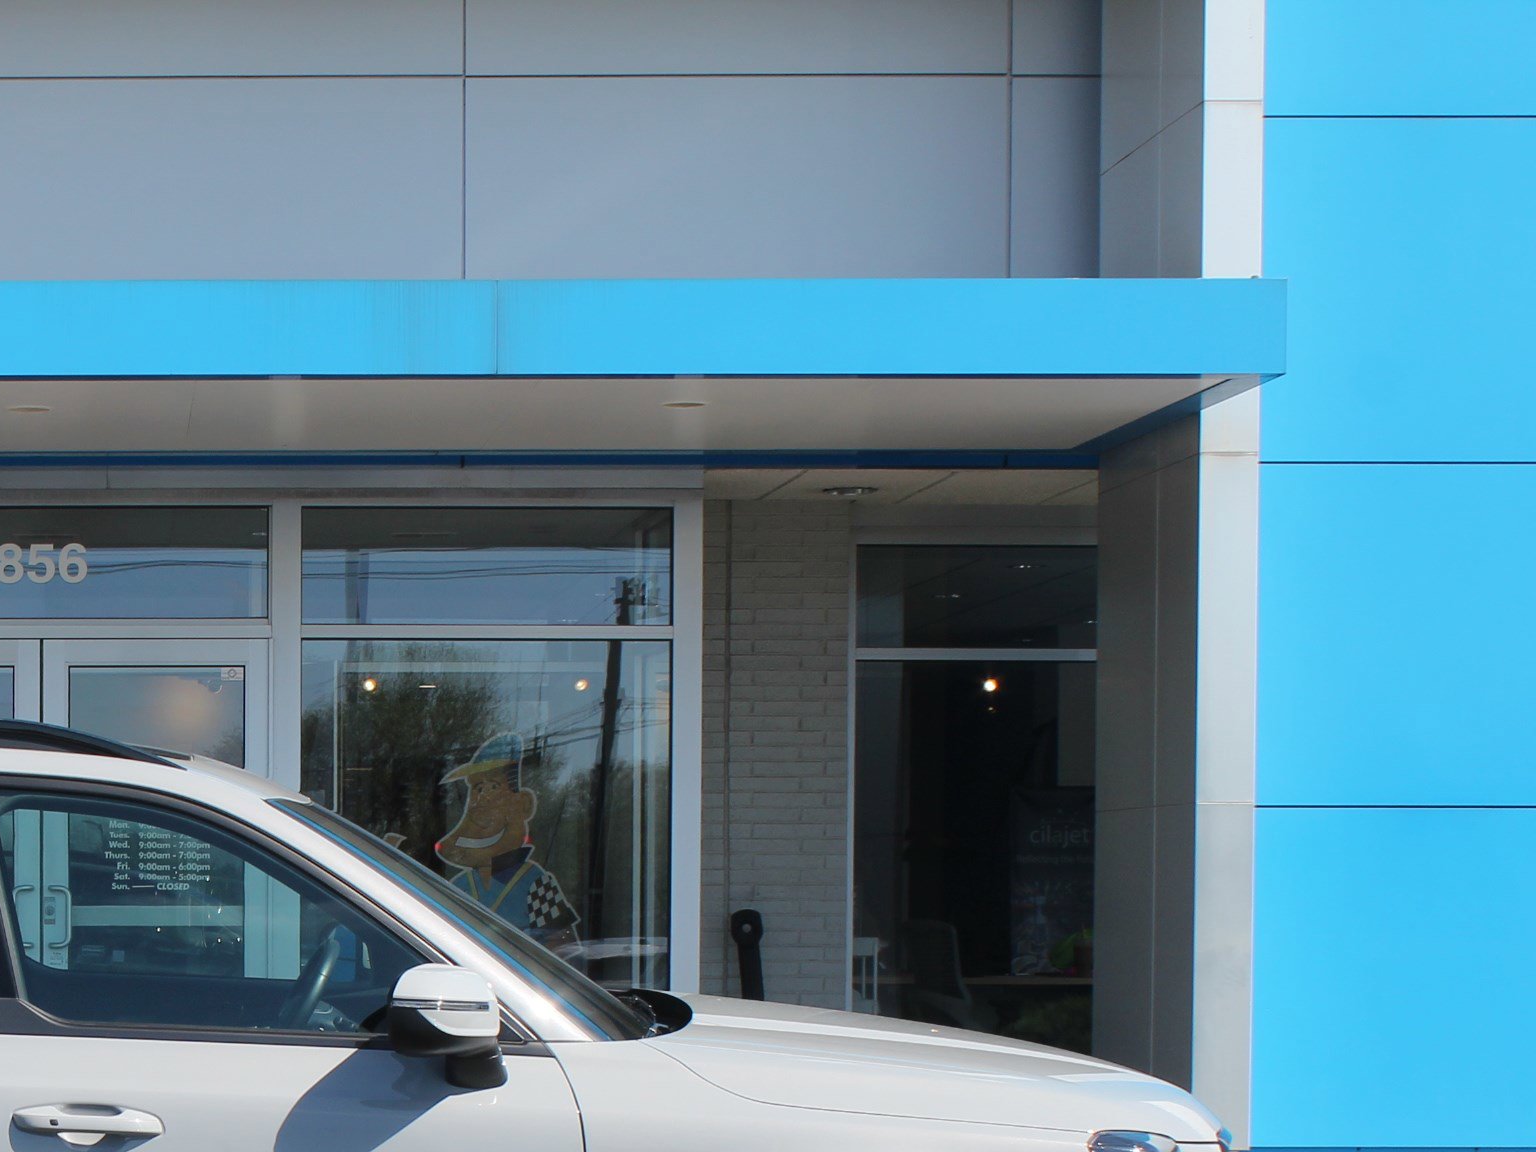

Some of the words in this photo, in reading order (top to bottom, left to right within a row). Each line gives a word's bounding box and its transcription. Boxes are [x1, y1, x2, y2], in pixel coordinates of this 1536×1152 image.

[109, 820, 130, 829] Mon.
[1030, 824, 1090, 849] cilajet
[108, 841, 131, 849] Wed.
[138, 841, 171, 849] 9:00am
[178, 841, 211, 850] 7:00pm
[104, 851, 131, 859] Thurs.
[138, 851, 171, 859] 9:00am
[178, 851, 211, 861] 7:00pm
[116, 862, 131, 870] Fri.
[138, 862, 171, 871] 9:00am
[178, 862, 211, 872] 6:00pm
[114, 872, 131, 880] Sat.
[138, 873, 171, 881] 9:00am
[178, 873, 211, 882] 5:00pm
[111, 882, 131, 890] Sun.
[156, 882, 190, 891] CLOSED
